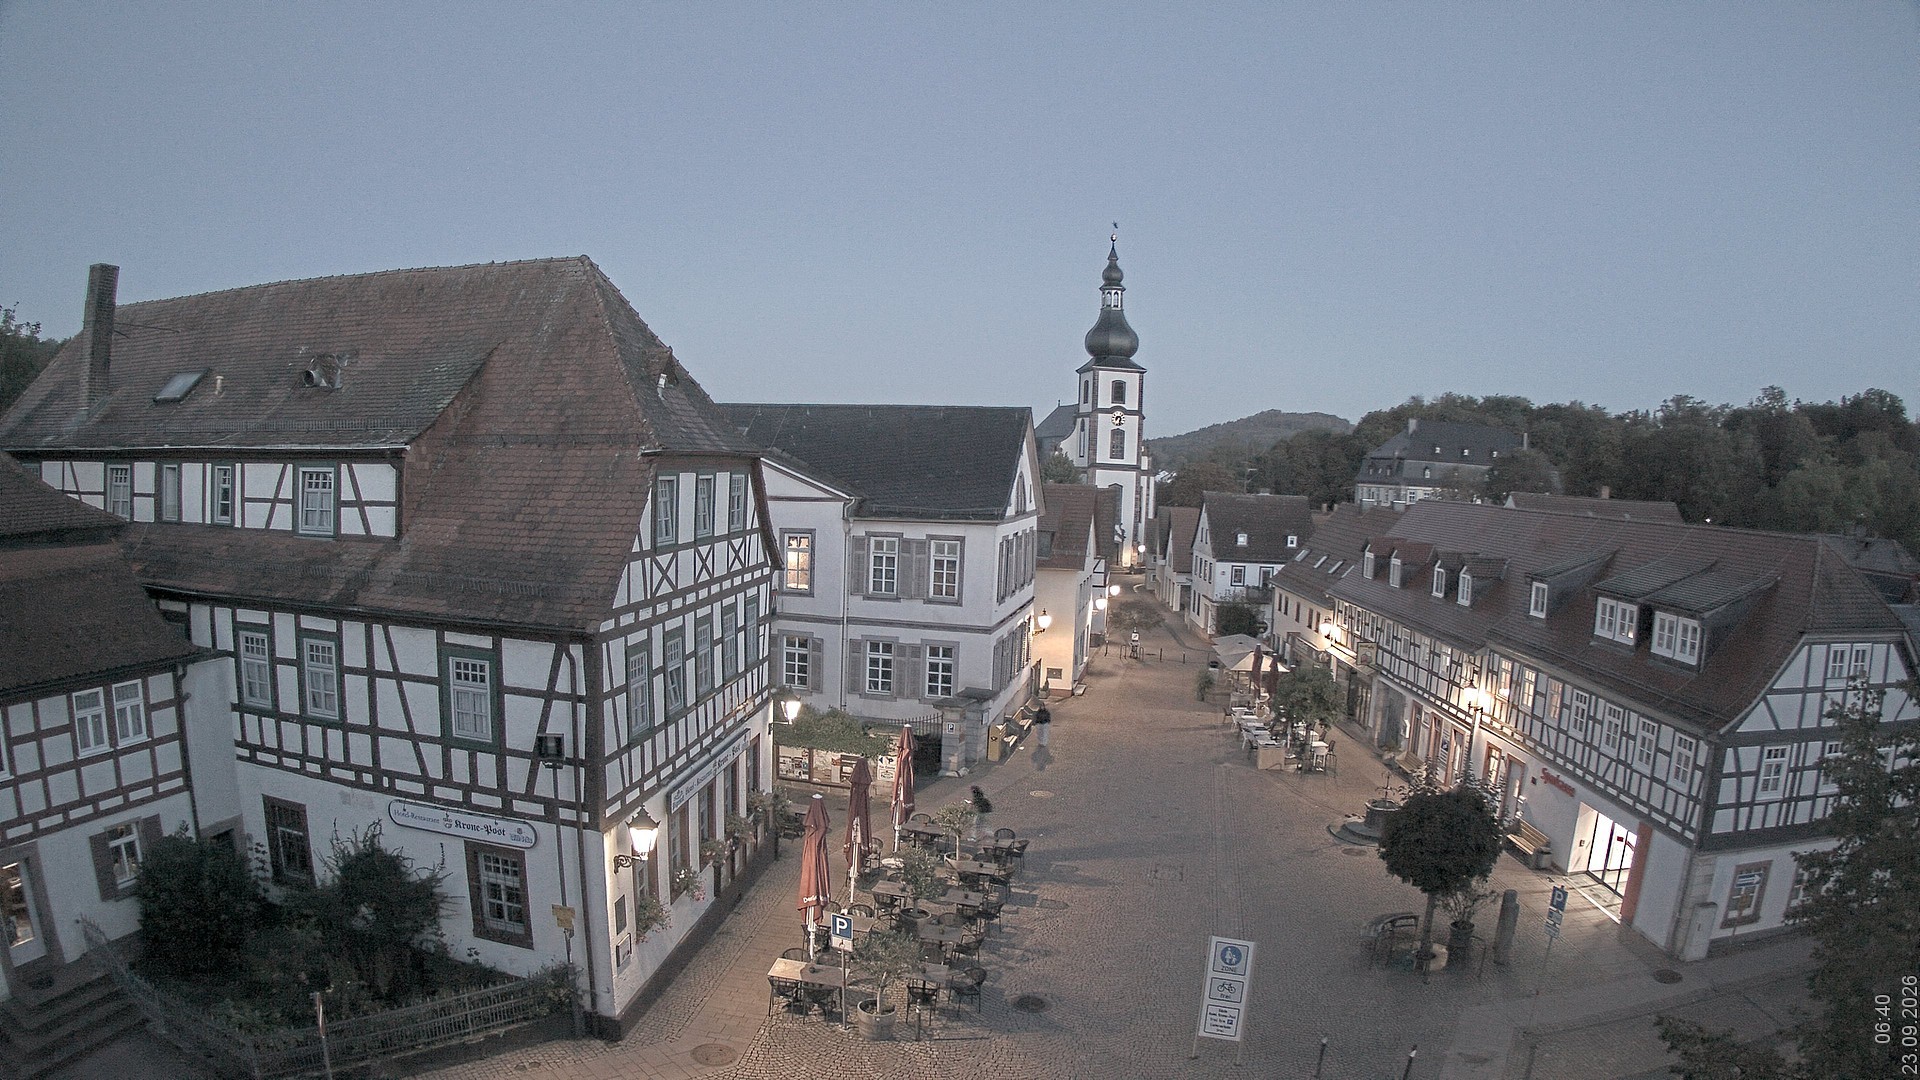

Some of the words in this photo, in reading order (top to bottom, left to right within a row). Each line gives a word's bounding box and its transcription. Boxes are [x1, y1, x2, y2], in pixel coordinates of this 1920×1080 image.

[454, 820, 506, 836] Krone-Post
[1553, 890, 1564, 906] P
[836, 917, 848, 935] P
